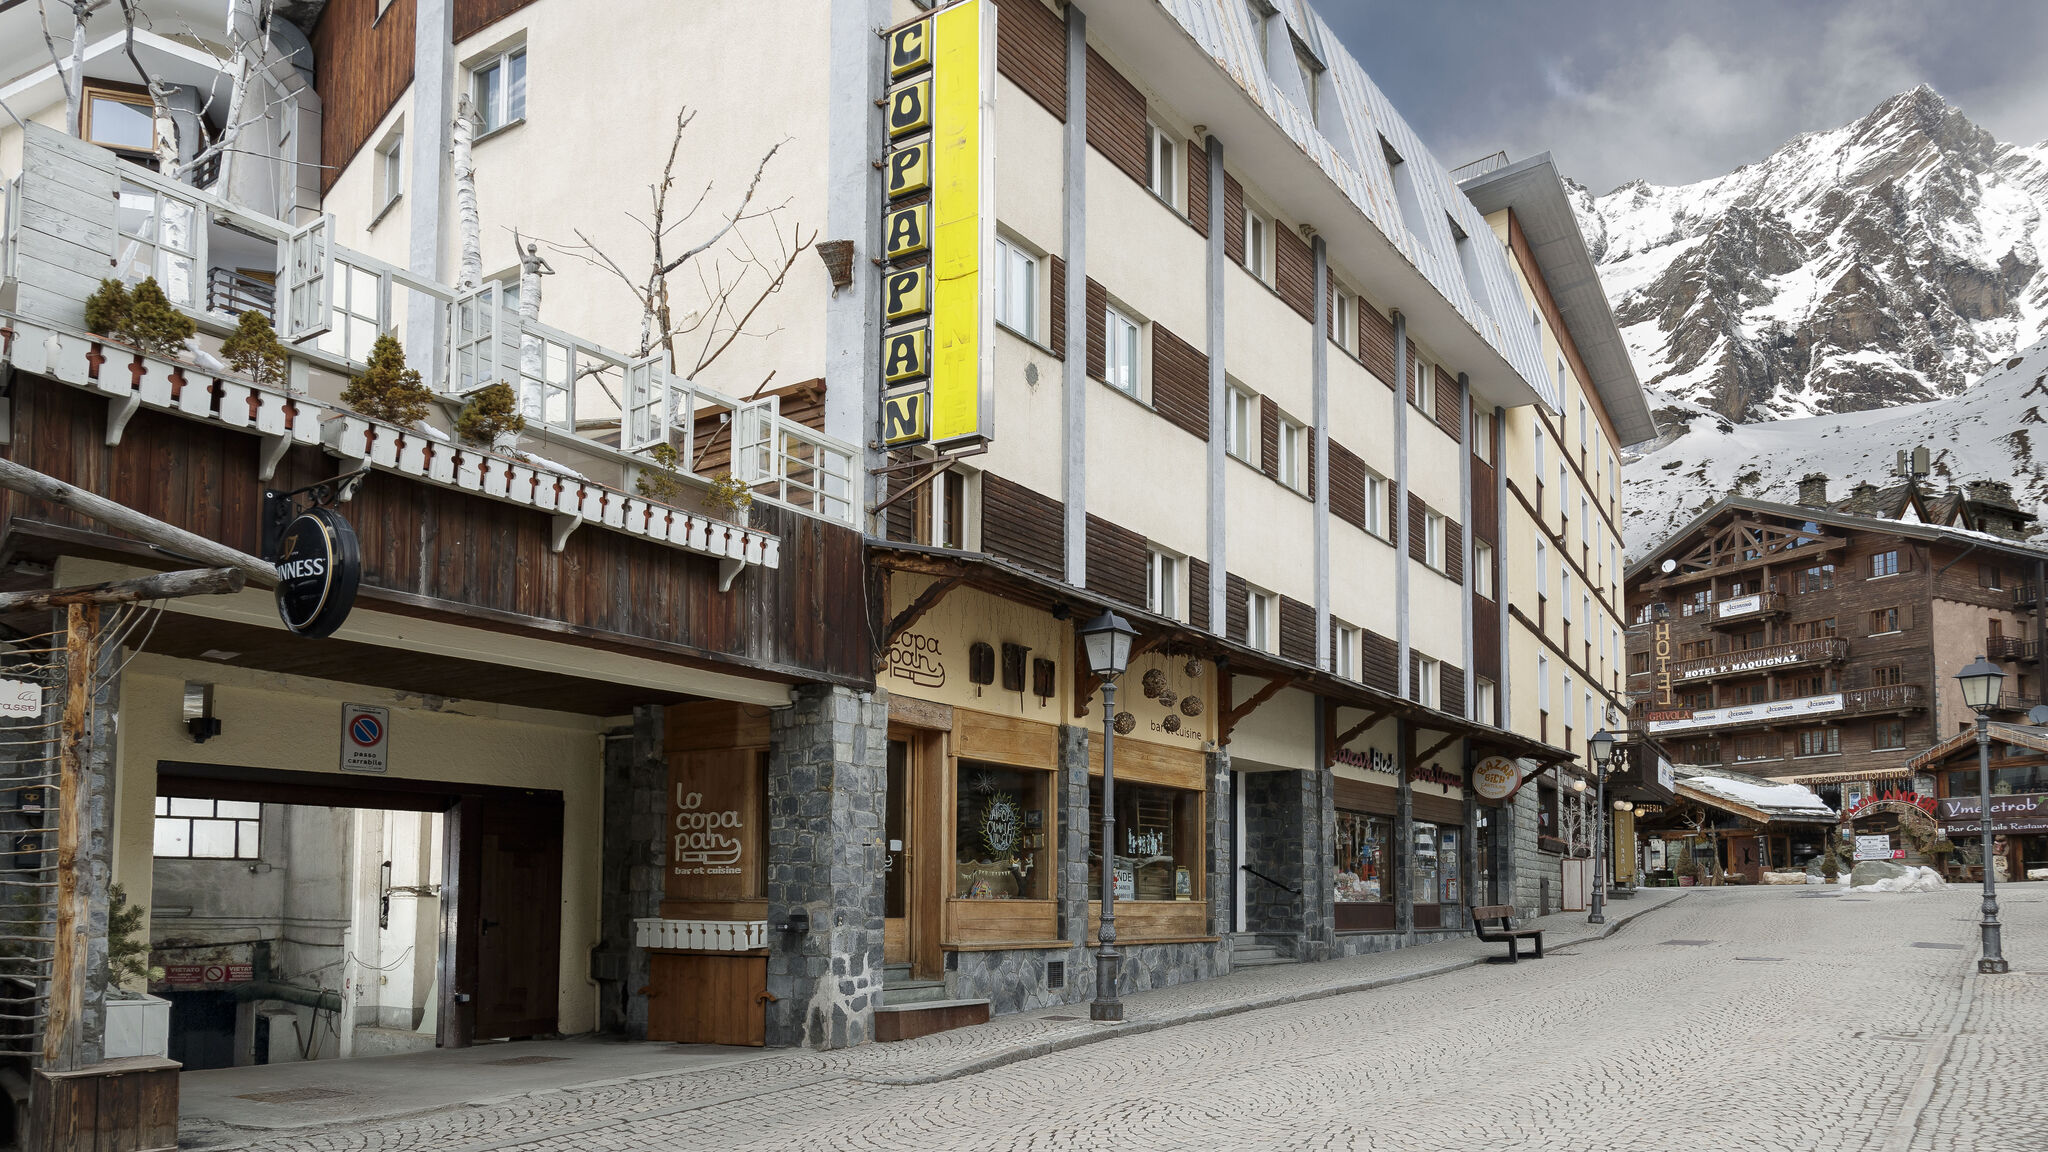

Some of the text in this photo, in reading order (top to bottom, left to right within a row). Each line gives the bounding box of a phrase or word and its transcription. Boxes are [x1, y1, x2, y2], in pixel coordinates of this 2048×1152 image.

[886, 22, 923, 439] COPAPAN
[277, 558, 324, 581] INNESS
[895, 631, 942, 662] opa
[1684, 667, 1716, 678] HOTEL
[1732, 654, 1798, 671] MAQUIGNAZ
[1151, 720, 1163, 732] bar
[1648, 710, 1690, 721] GRIVOLA
[347, 758, 383, 766] carrabile
[353, 751, 377, 759] passo
[1477, 759, 1514, 780] BAZAR
[676, 782, 702, 809] la
[1848, 789, 1938, 815] MON AMOUR
[1946, 798, 2037, 817] Ymeetrob
[676, 811, 743, 840] copa
[1967, 823, 2008, 832] Cocails
[2010, 822, 2048, 830] Restaur
[675, 832, 731, 861] pan
[675, 867, 692, 875] bar
[707, 866, 742, 875] cuisine
